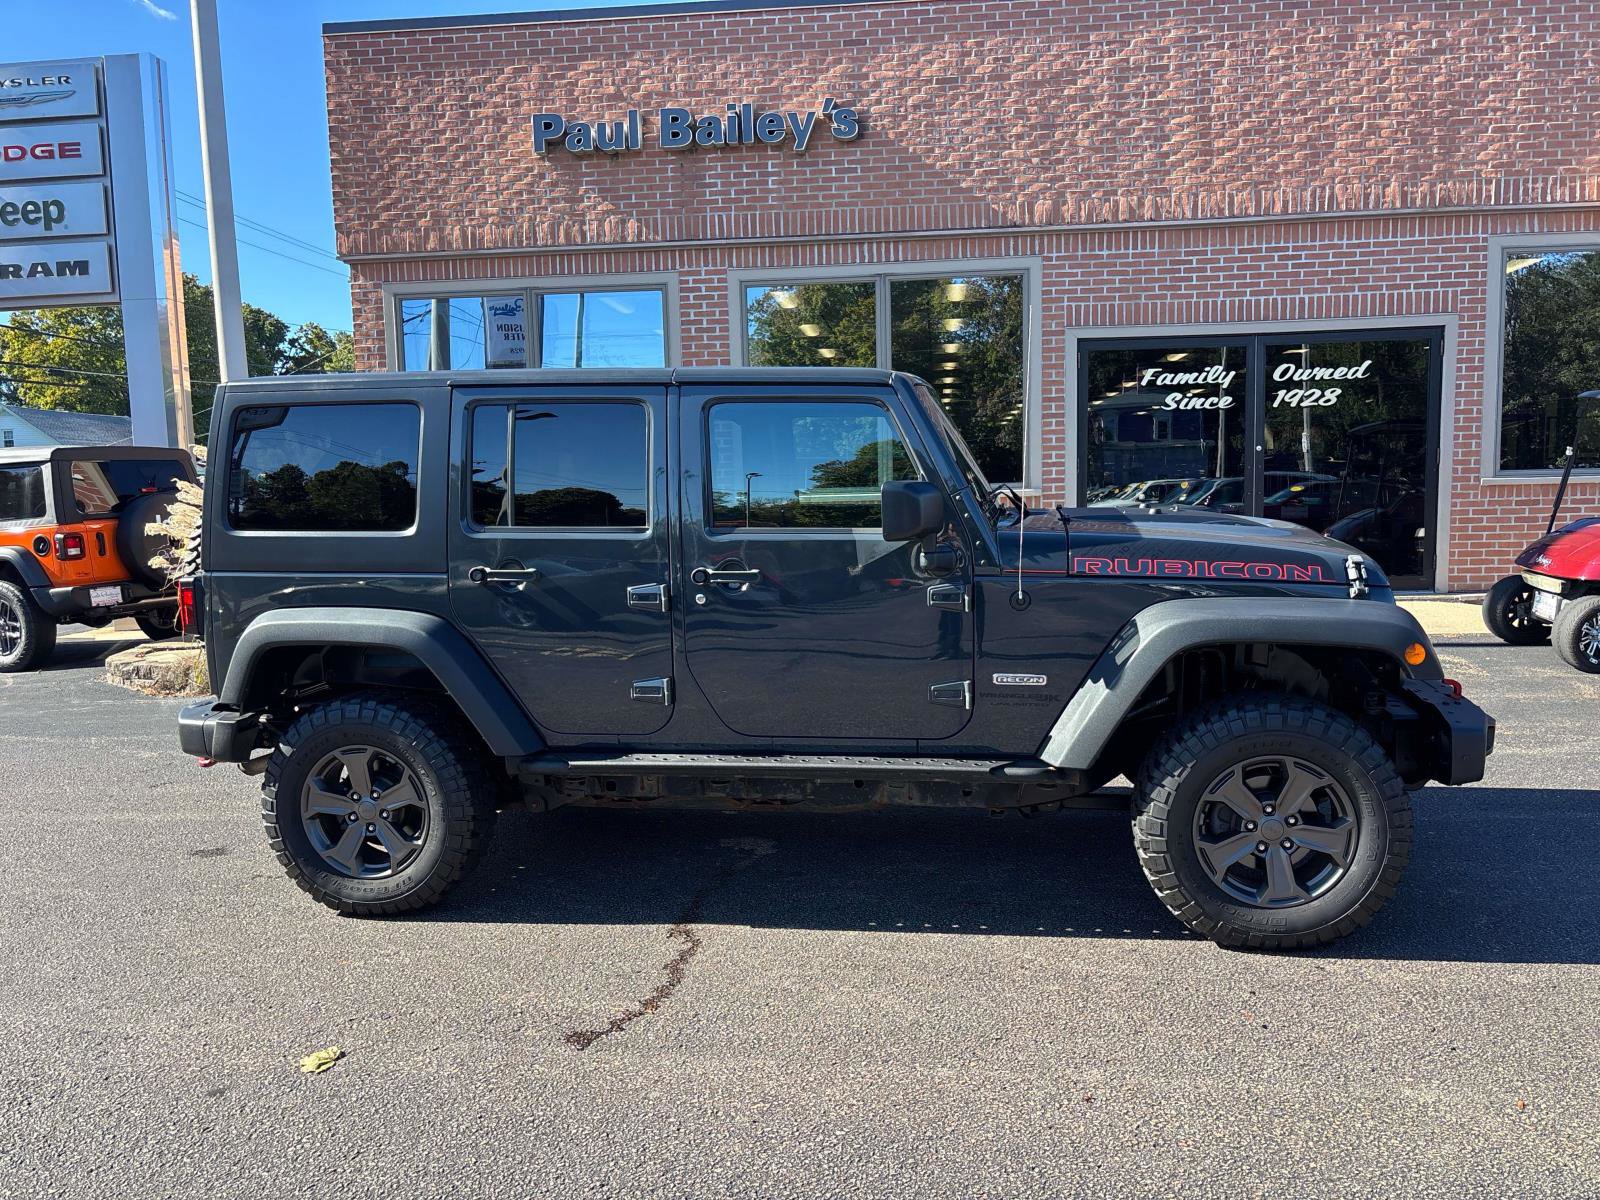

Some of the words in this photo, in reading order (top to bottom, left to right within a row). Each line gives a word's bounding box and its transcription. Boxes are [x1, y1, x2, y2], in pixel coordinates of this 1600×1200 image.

[532, 109, 641, 152] Paul
[659, 97, 859, 151] Bailey's
[0, 142, 82, 161] DGE
[0, 261, 90, 279] RAM
[1140, 365, 1236, 388] Family
[1272, 360, 1373, 382] Owned
[1160, 392, 1235, 411] Since
[1272, 387, 1342, 408] 1928
[1074, 557, 1326, 582] RUBICON
